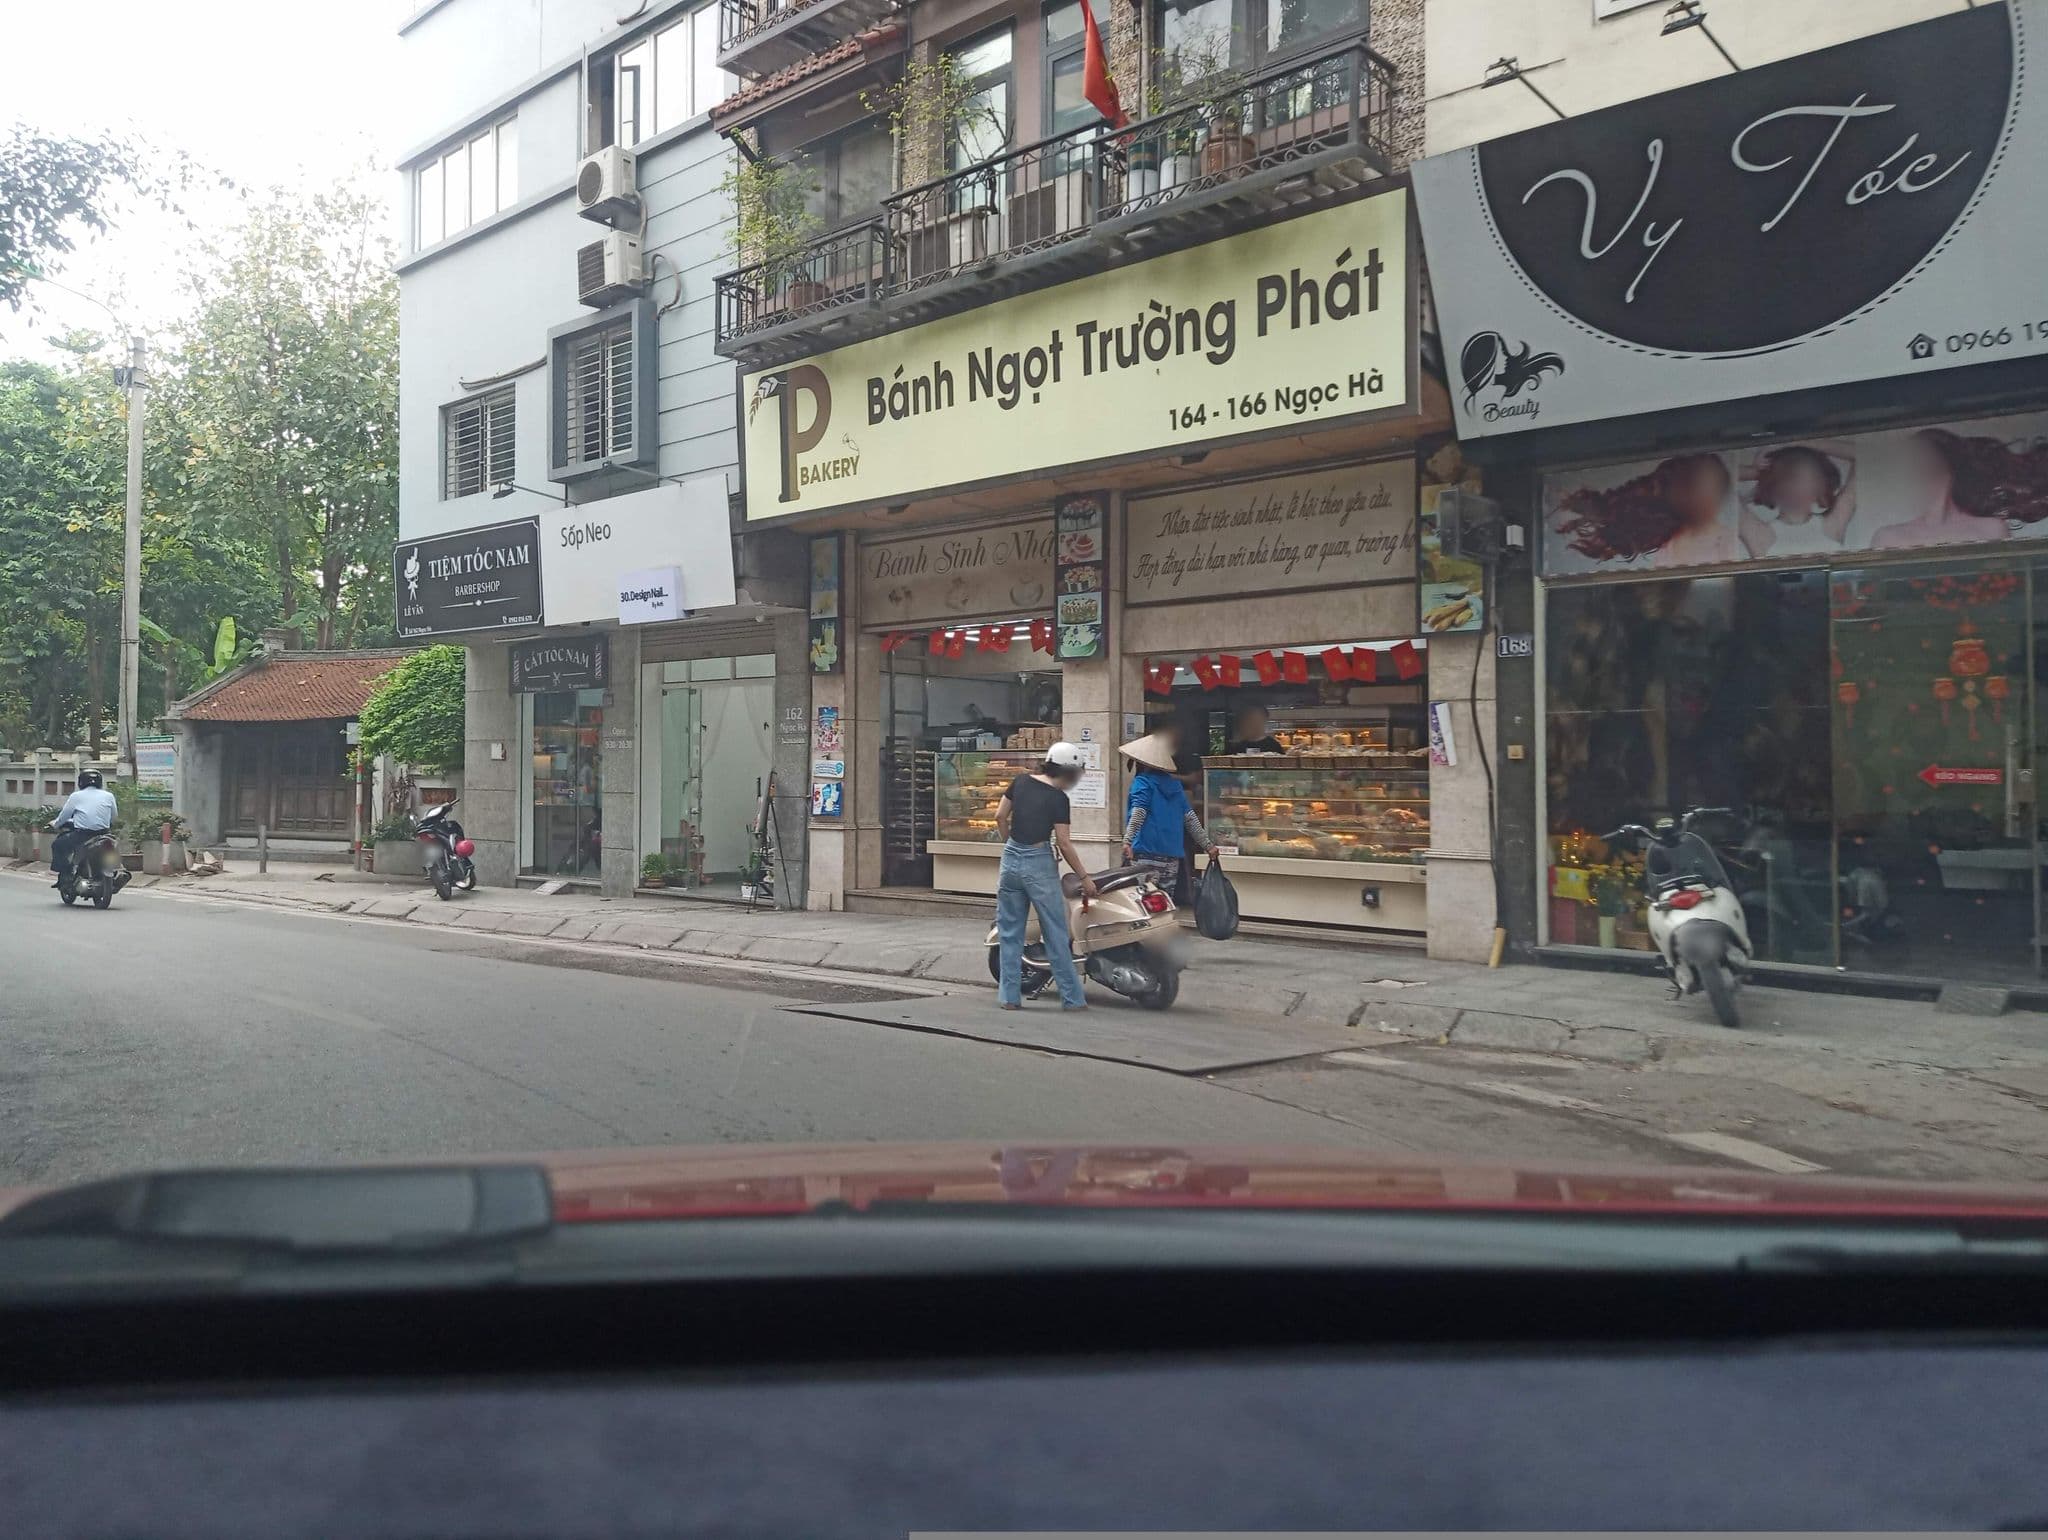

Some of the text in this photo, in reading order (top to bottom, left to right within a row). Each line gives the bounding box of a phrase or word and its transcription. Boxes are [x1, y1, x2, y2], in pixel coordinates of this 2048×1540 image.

[1522, 92, 1972, 303] Vy Tóc
[867, 247, 1384, 426] Bánh Ngọt Trường Phát
[1946, 327, 2012, 352] 0966
[1169, 404, 1206, 431] 164
[1228, 392, 1267, 419] 166
[1275, 383, 1340, 415] Ngọc
[1349, 367, 1384, 398] Hà
[1483, 399, 1541, 422] Beauty
[800, 455, 860, 486] BAKERY
[561, 522, 611, 550] Sốp Neo
[428, 545, 530, 581] TIỆM TÓC NAM
[869, 529, 1055, 578] Bánh Sinh Nhậ
[455, 580, 501, 597] BARBERSHOP
[565, 649, 589, 668] NAM
[1501, 638, 1529, 655] 168
[785, 708, 803, 720] 162
